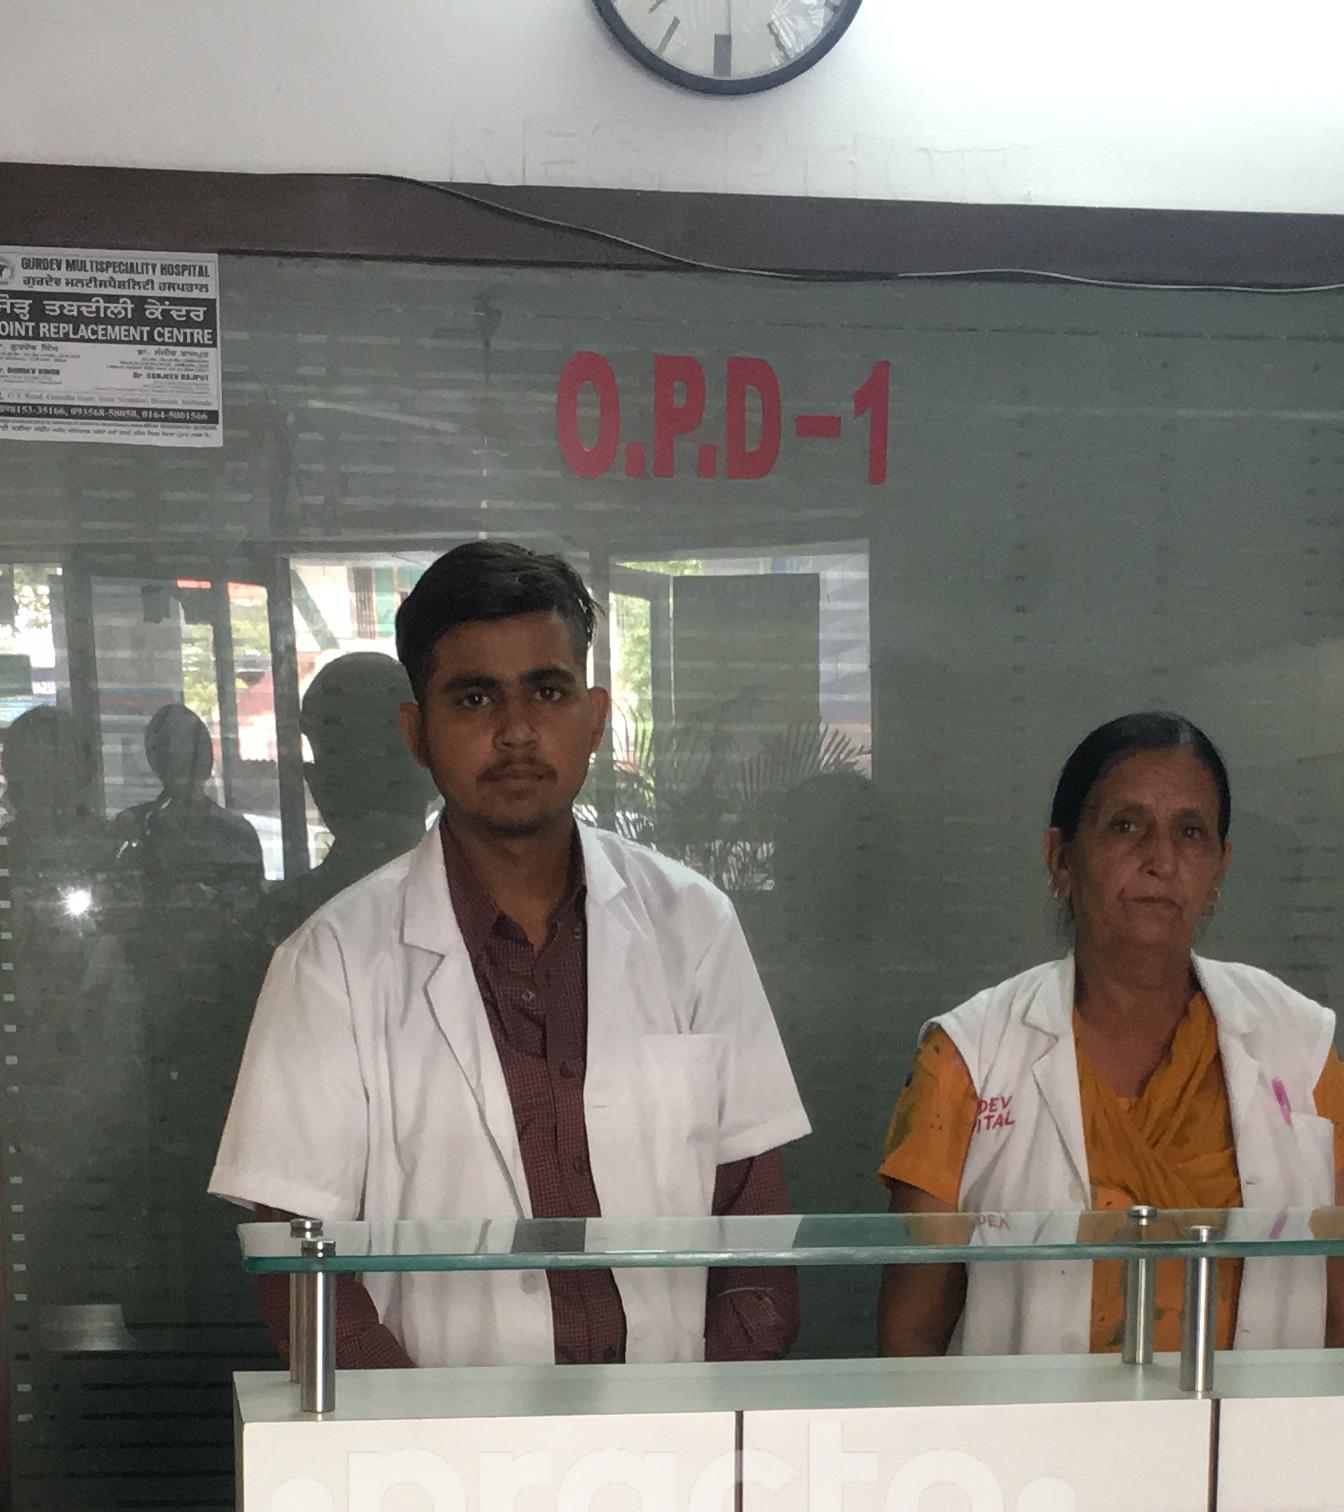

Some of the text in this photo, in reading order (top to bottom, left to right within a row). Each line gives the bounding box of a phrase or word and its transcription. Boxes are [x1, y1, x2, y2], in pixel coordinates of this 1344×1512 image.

[21, 256, 211, 278] GURDEV MULTISPECIALITY HOSPITAL
[42, 296, 135, 319] ਤਬਦੀਲੀ
[39, 322, 150, 341] REPLACEMENT
[153, 326, 213, 344] CENTRE
